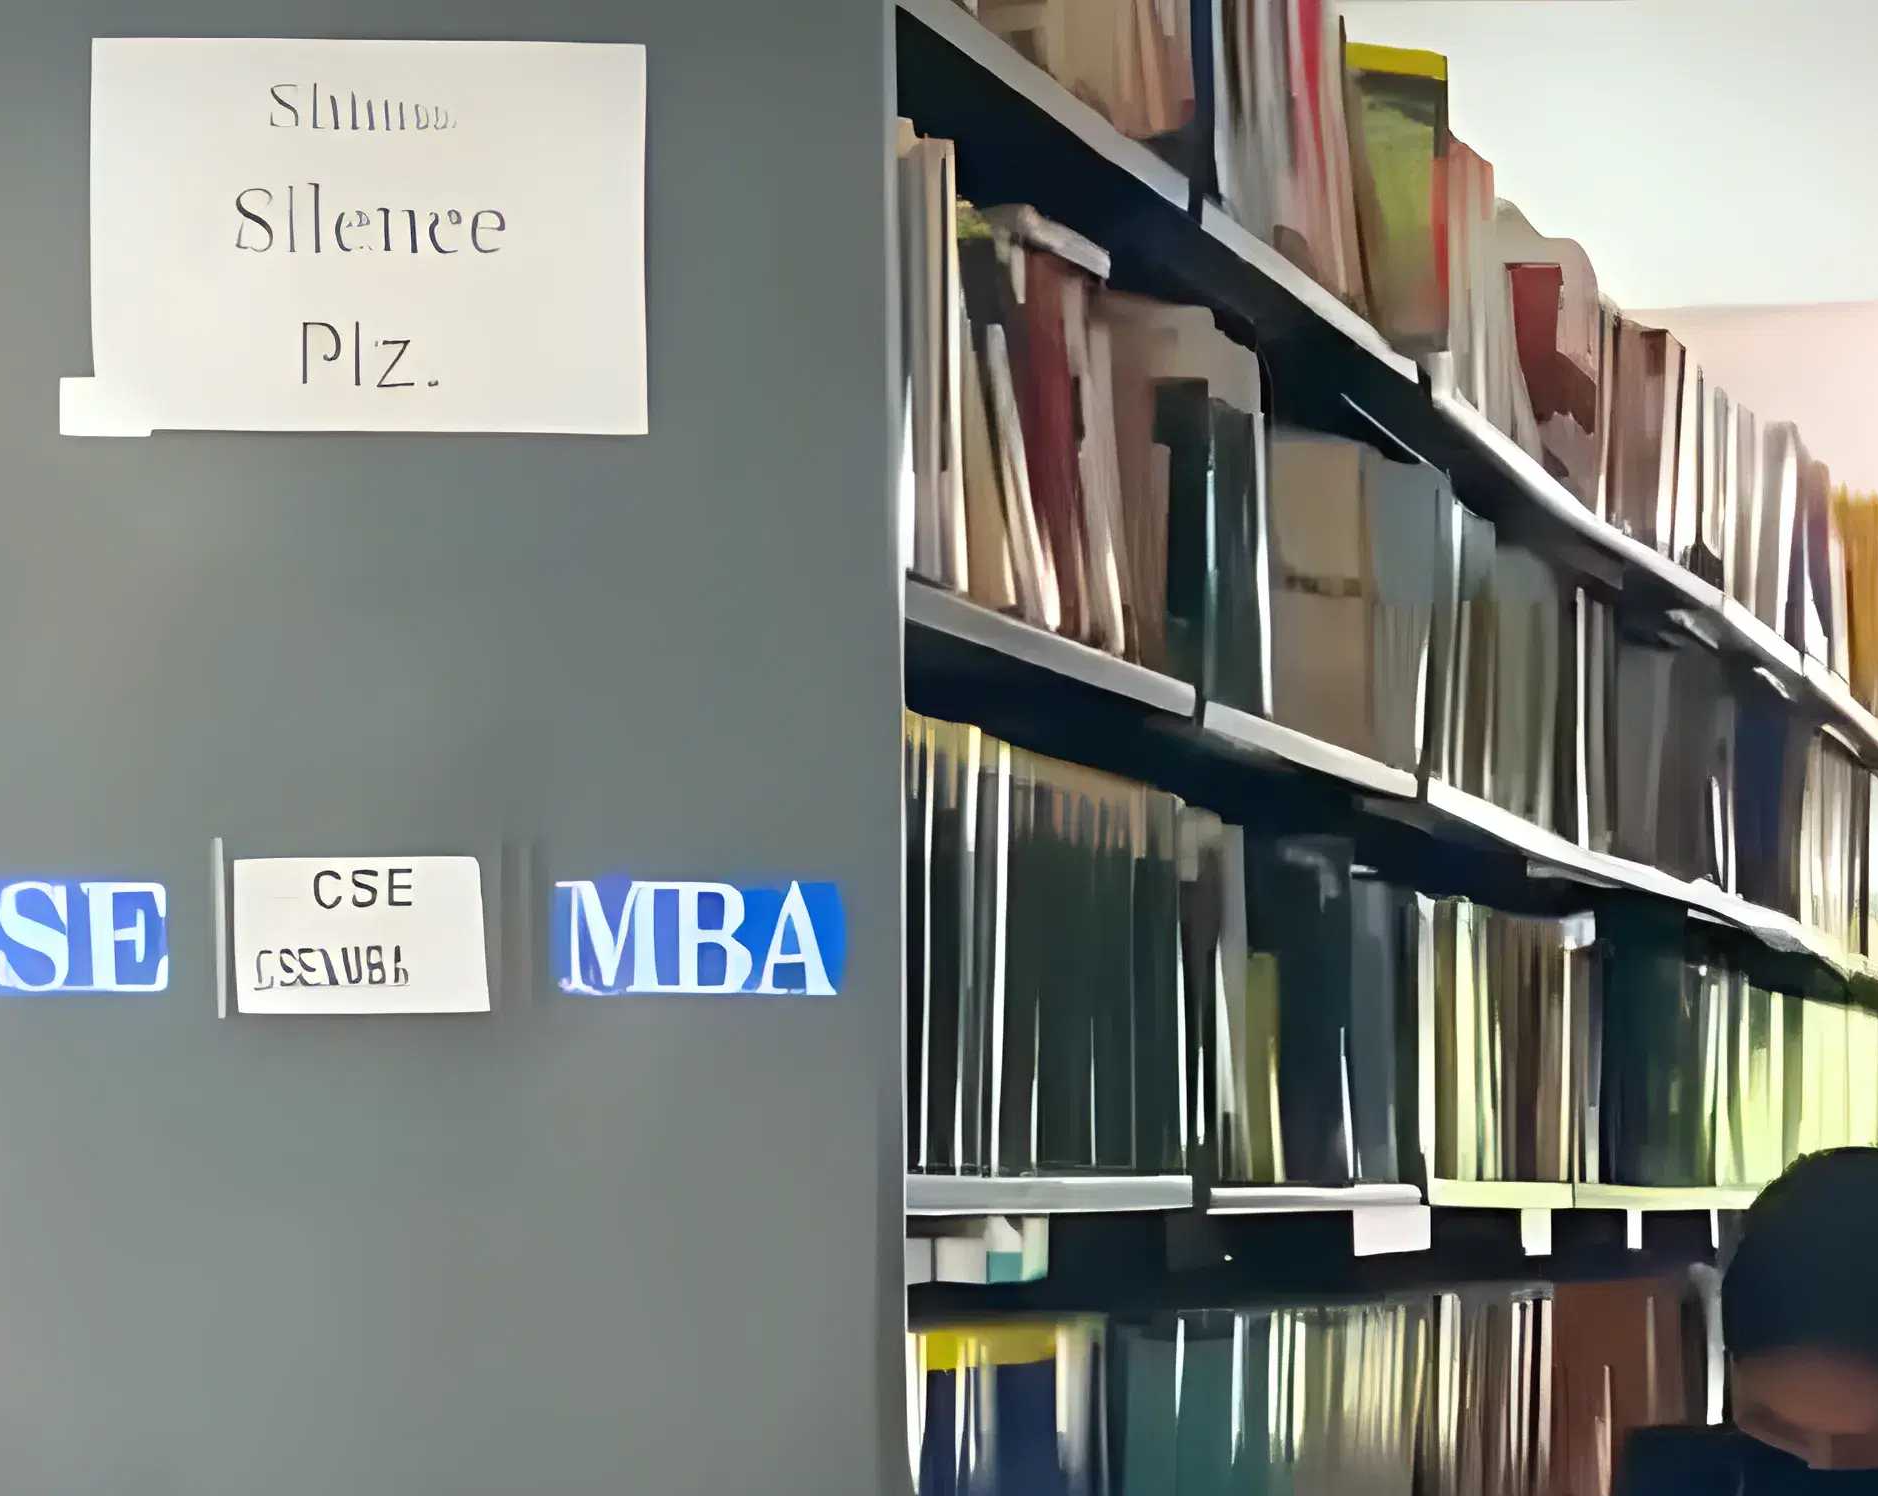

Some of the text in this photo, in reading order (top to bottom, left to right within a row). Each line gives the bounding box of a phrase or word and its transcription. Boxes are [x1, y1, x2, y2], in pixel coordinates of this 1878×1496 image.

[301, 320, 441, 389] Plz.
[312, 867, 413, 910] CSE
[554, 879, 838, 997] MBA
